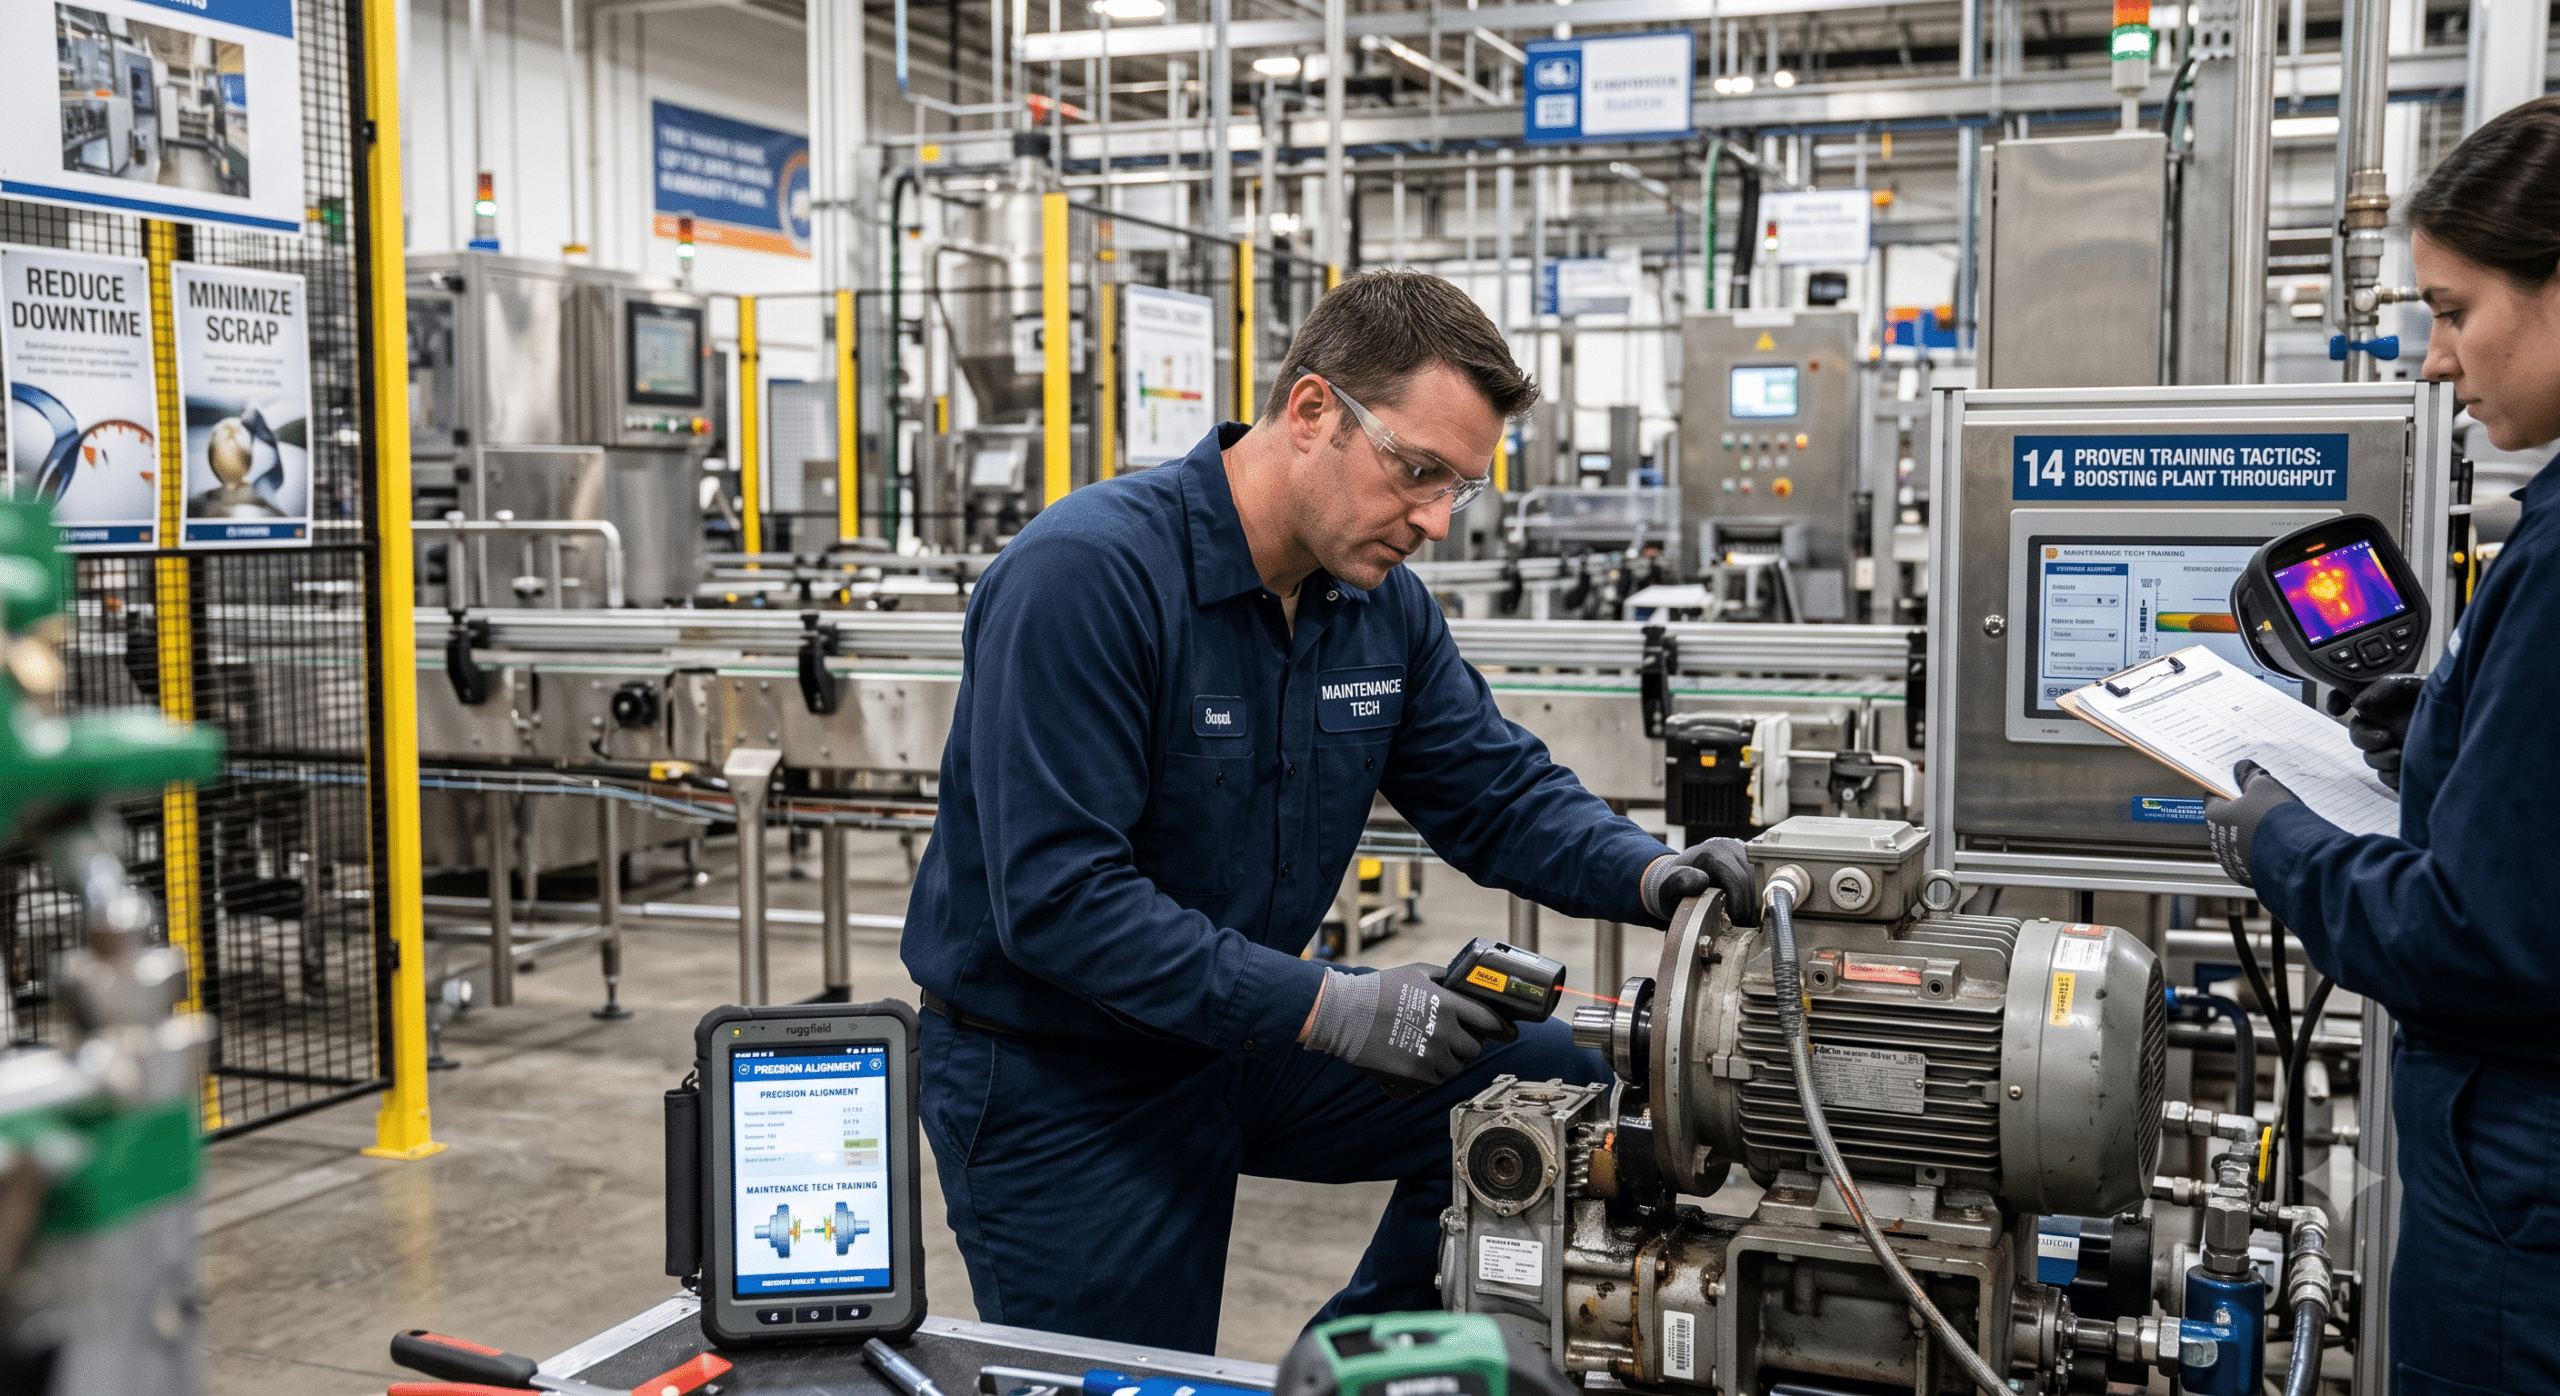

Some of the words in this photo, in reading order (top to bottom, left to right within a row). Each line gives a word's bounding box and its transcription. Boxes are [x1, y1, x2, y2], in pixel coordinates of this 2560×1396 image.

[27, 267, 125, 303] REDUCE
[189, 281, 293, 316] MINIMIZE
[12, 301, 141, 337] DOWNTIME
[206, 315, 279, 345] SCRAP
[2022, 449, 2066, 487] 14
[2074, 448, 2145, 466] PROVEN
[2149, 448, 2235, 466] TRAINING
[2240, 447, 2321, 466] TACTICS:
[2074, 469, 2157, 487] BOOSTING
[2162, 469, 2217, 487] PLANT
[2221, 469, 2336, 487] THROUGHPUT
[1321, 678, 1402, 700] MAINTENANCE
[1350, 700, 1380, 717] TECH
[786, 1023, 832, 1036] ruggfield
[804, 1061, 862, 1073] ALIGNMENT
[760, 1089, 807, 1099] PRECISION
[809, 1087, 859, 1097] ALIGNMENT
[746, 1184, 809, 1195] MAINTENANCE
[812, 1183, 834, 1192] TECH
[836, 1181, 878, 1191] TRAINING
